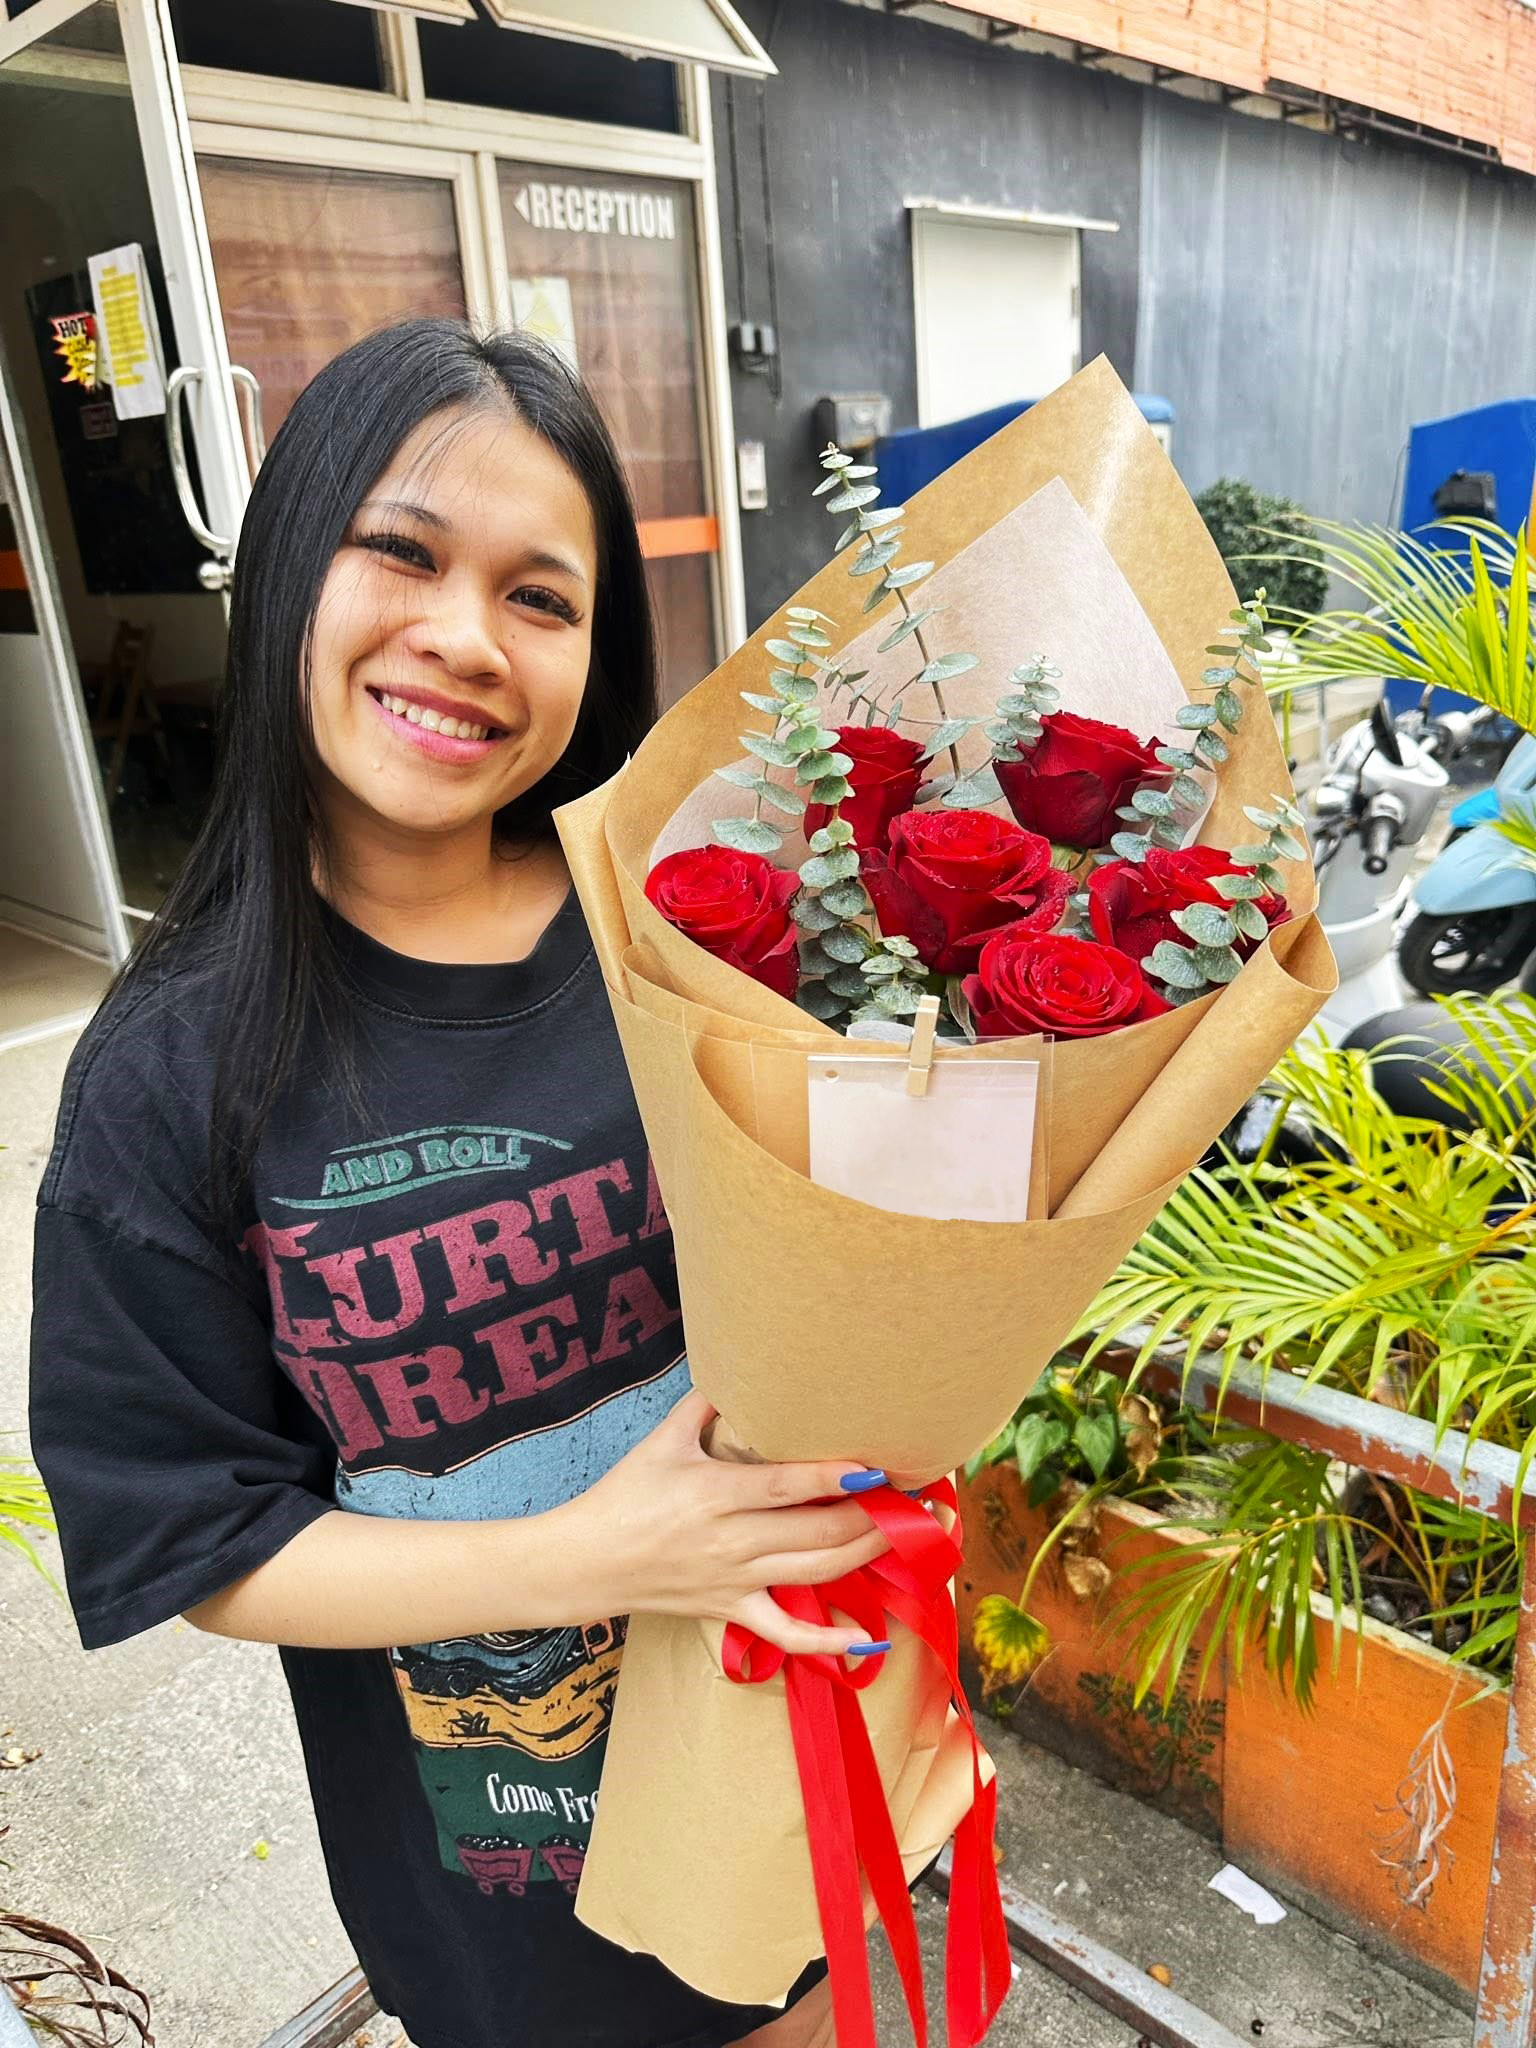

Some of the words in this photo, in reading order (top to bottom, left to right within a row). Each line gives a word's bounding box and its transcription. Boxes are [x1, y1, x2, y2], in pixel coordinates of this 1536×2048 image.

[528, 181, 675, 240] RECEPTION
[58, 317, 87, 339] HOT
[320, 1150, 413, 1196] AND
[417, 1135, 531, 1174] ROLL
[486, 1772, 557, 1816] Come
